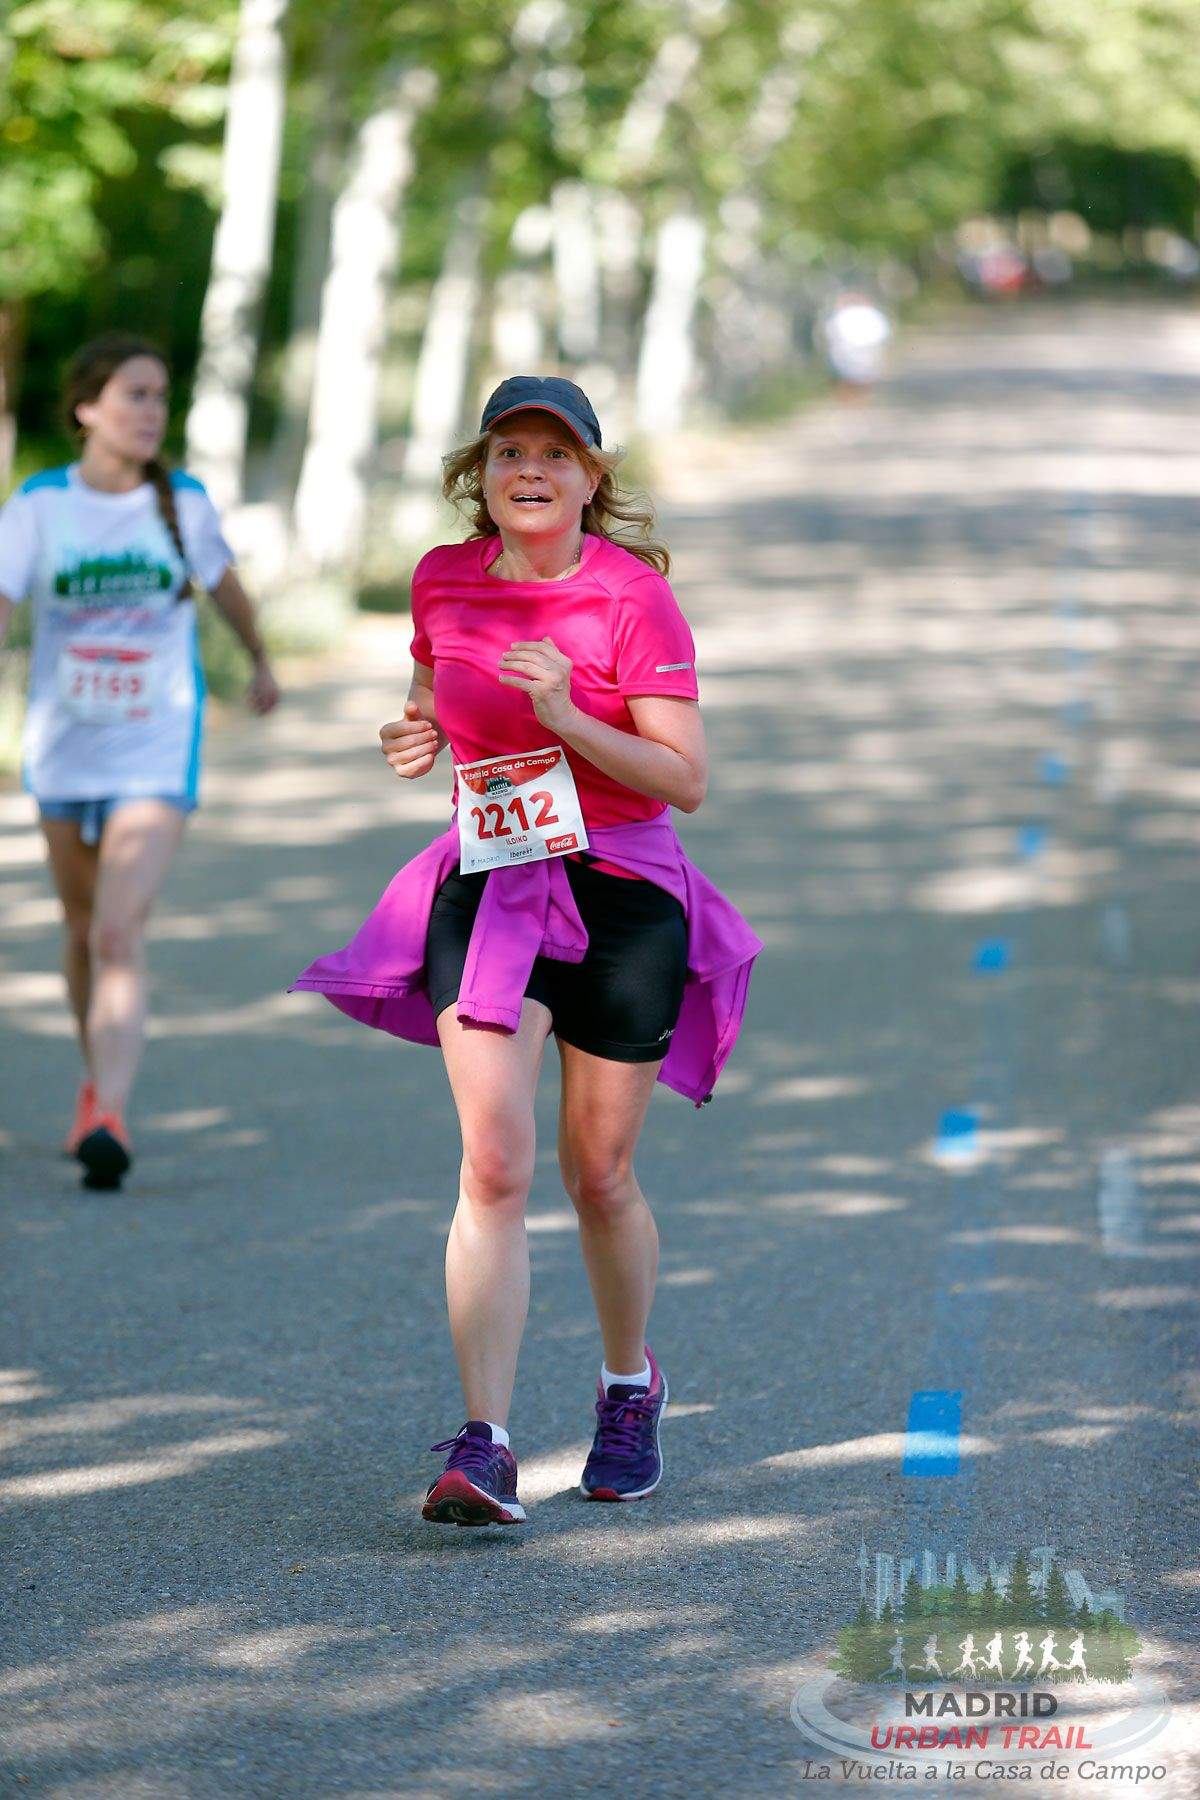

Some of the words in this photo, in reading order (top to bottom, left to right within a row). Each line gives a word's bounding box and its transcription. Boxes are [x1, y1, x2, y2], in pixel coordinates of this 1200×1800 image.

[491, 765, 513, 774] Casa
[526, 757, 556, 767] Campo
[470, 791, 560, 840] 2212
[505, 835, 528, 846] ILDIKO
